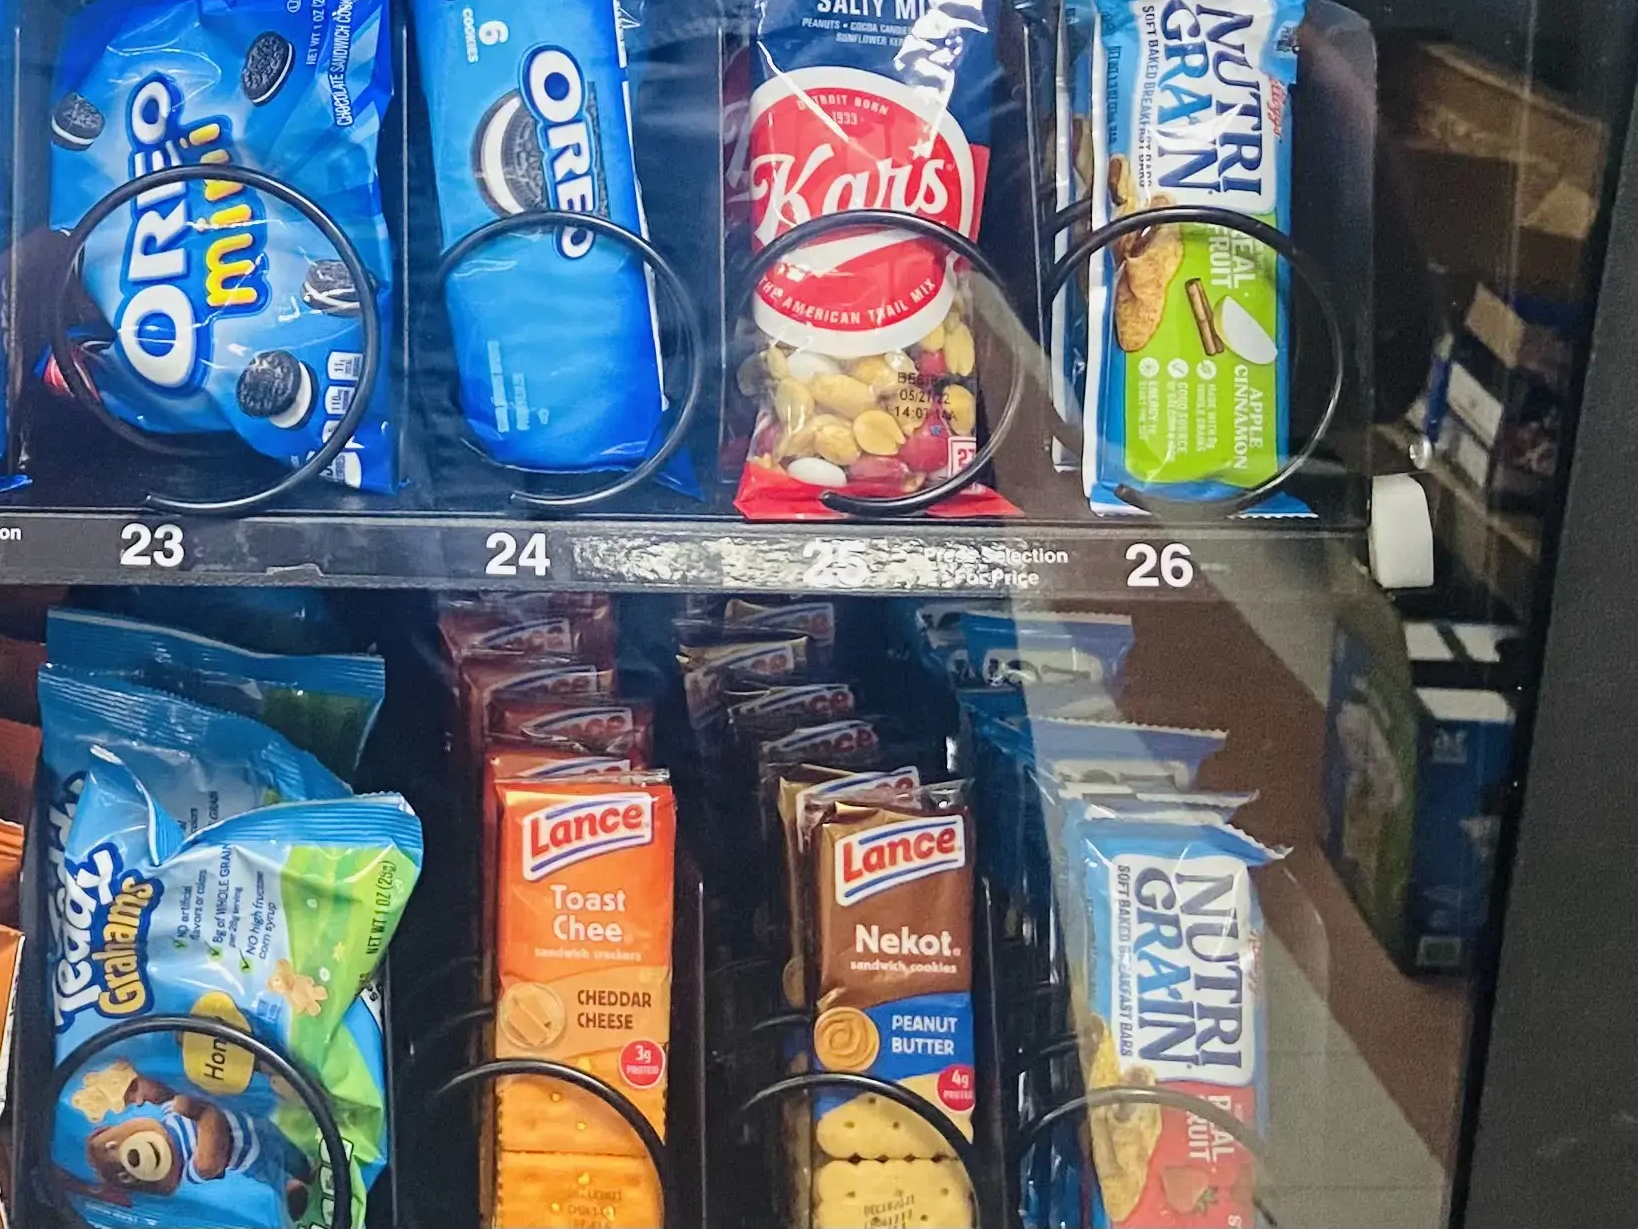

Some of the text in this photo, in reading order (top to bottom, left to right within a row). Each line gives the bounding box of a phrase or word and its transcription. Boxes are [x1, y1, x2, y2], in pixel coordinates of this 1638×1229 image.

[478, 20, 509, 46] 6
[1141, 5, 1160, 80] SOFT BAKED
[326, 72, 353, 127] CHOCOLATE
[854, 96, 890, 116] BORN
[1195, 3, 1263, 197] NUTRI
[529, 48, 596, 259] OREO
[118, 81, 196, 388] OREO
[782, 277, 937, 325] AMERICAN TRAIL MIX
[1233, 363, 1249, 470] CINNAMON
[1249, 386, 1264, 449] APPLE
[119, 523, 185, 566] 23
[485, 531, 551, 577] 24
[981, 548, 1069, 565] Selection
[991, 570, 1040, 587] Price
[1125, 543, 1194, 588] 26
[530, 803, 644, 858] Lance
[841, 825, 957, 884] Lance
[549, 884, 627, 913] Toast
[91, 875, 154, 1015] Grahams
[365, 934, 382, 955] NET
[552, 915, 623, 943] Chee
[854, 923, 955, 956] Nekot
[534, 947, 590, 960] sandwich
[849, 958, 958, 975] sandwich cookies
[1133, 866, 1199, 1070] GRAIN
[1175, 872, 1243, 1070] NUTRI
[577, 988, 652, 1009] CHEDDAR
[577, 1011, 635, 1031] CHEESE
[891, 1014, 958, 1033] PEANUT
[1120, 1020, 1133, 1057] BARS
[634, 1044, 652, 1063] 3g
[891, 1036, 956, 1056] BUTTER
[951, 1069, 971, 1087] 4g
